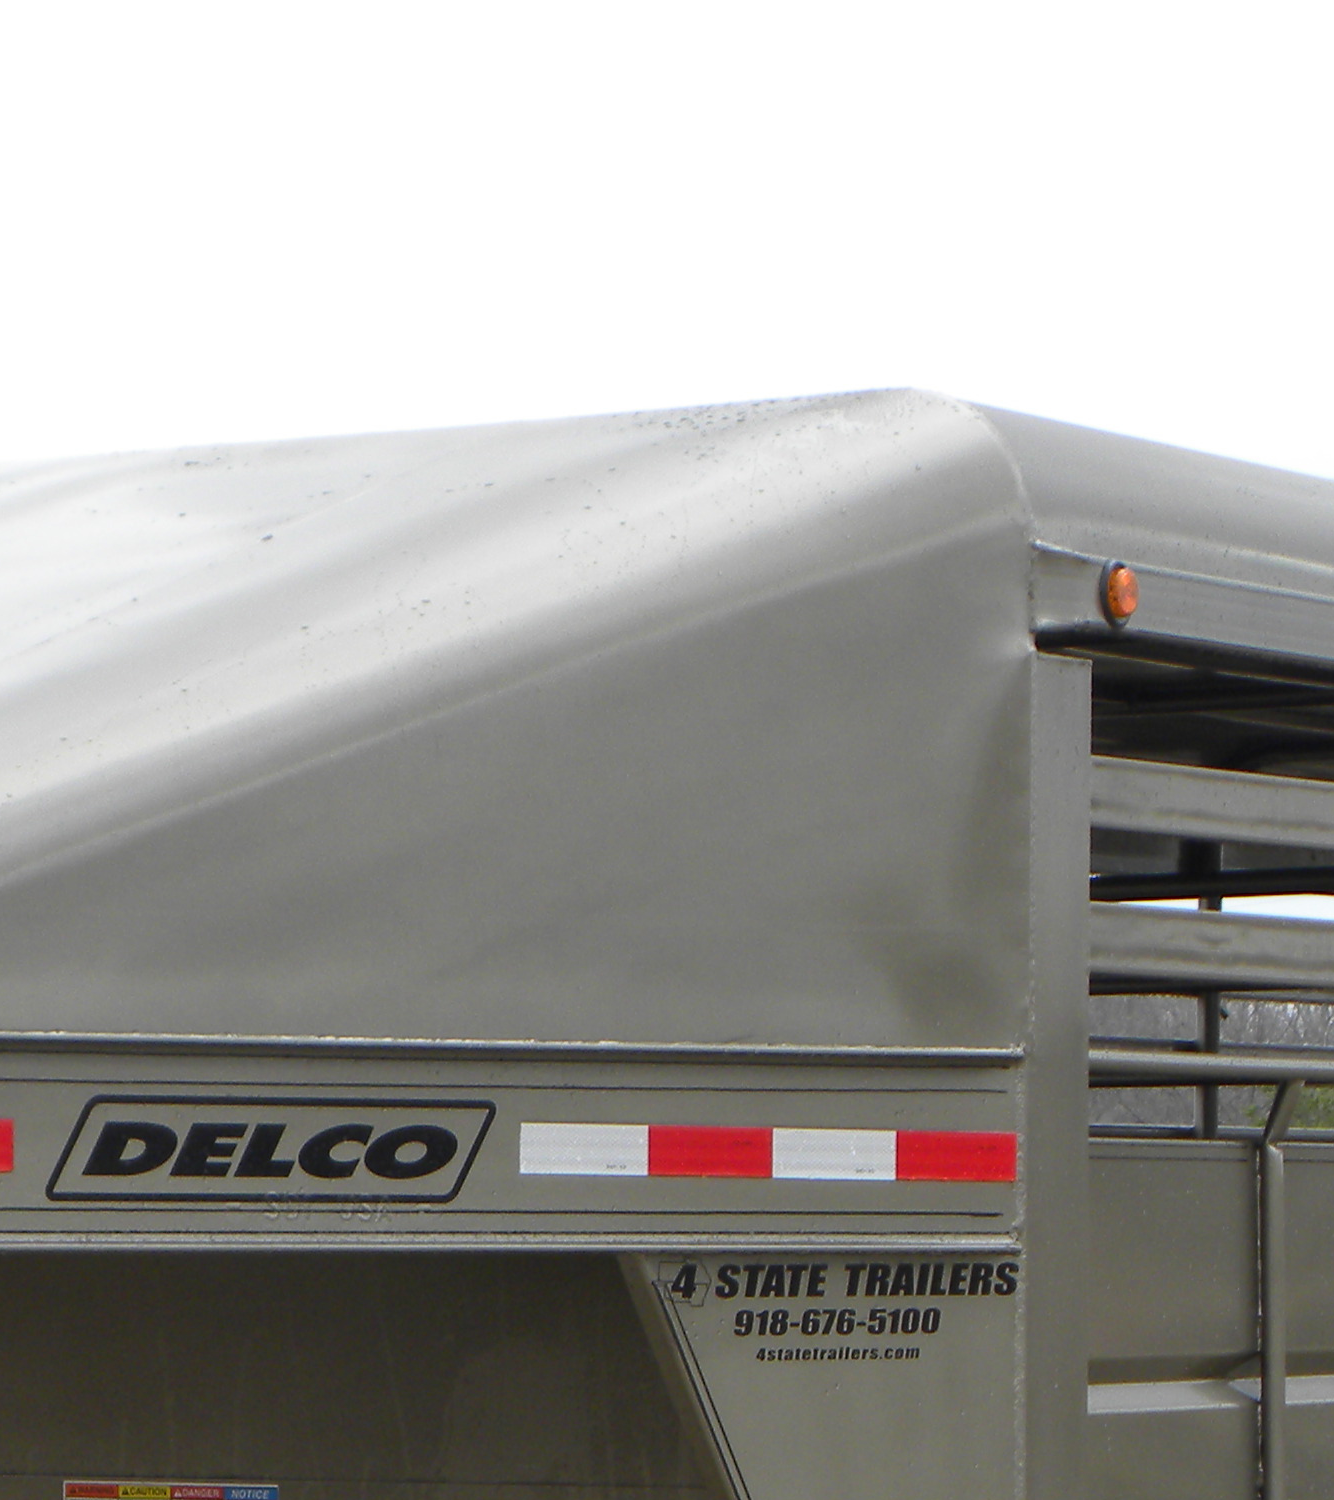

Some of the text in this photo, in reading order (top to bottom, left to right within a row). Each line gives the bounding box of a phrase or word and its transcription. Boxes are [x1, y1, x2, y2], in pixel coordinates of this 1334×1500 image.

[81, 1121, 459, 1179] DELCO
[671, 1262, 1020, 1299] 4 STATE TRAILERS
[733, 1307, 942, 1337] 918-676-5100
[755, 1346, 921, 1362] 4statetrailers.com
[129, 1486, 168, 1497] CAUTION
[181, 1488, 221, 1498] DANGER
[231, 1489, 271, 1500] NOTICE
